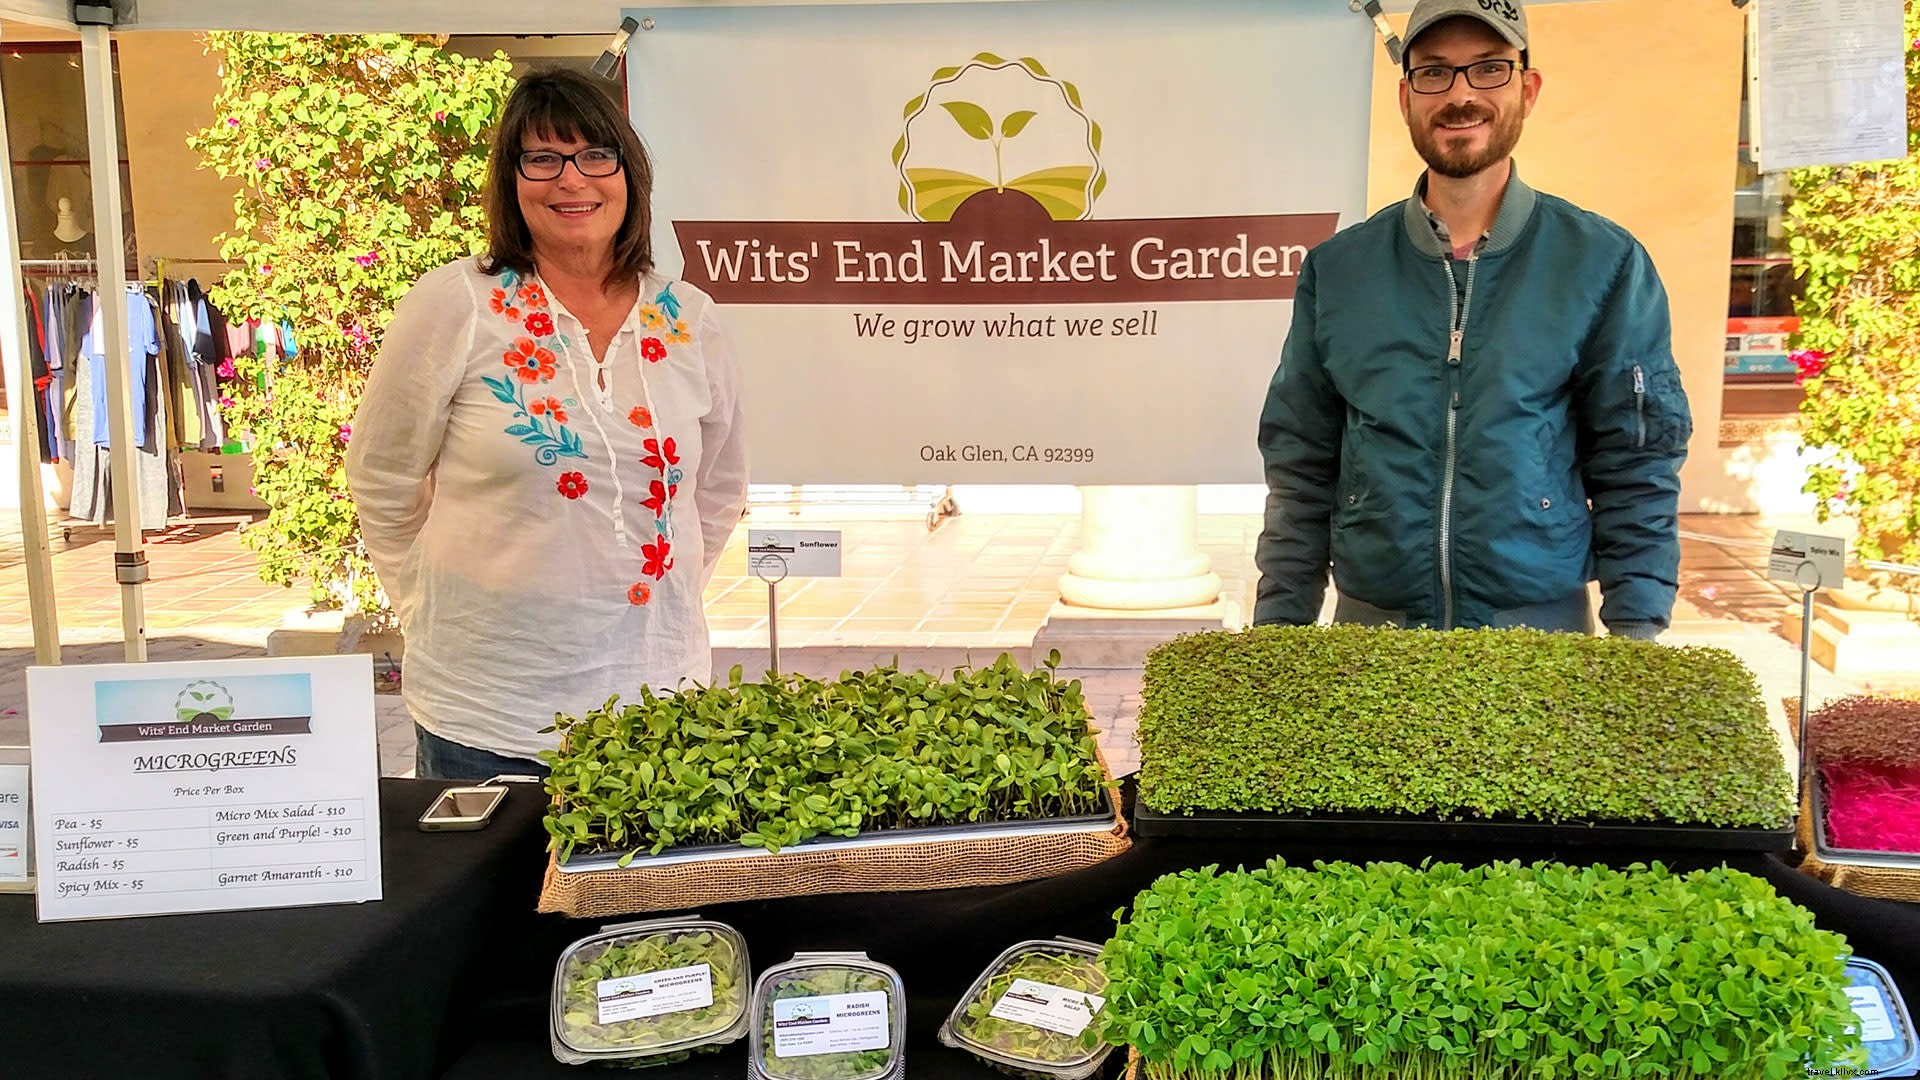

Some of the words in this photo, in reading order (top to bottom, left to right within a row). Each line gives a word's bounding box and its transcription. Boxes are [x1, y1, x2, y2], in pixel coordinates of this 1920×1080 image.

[696, 238, 819, 283] Wits'
[833, 239, 928, 283] End
[939, 238, 1118, 283] Market
[1130, 233, 1308, 281] Garden
[853, 312, 896, 338] We
[903, 318, 975, 345] grow
[983, 312, 1056, 338] what
[1064, 318, 1104, 337] we
[1111, 310, 1159, 337] sell
[920, 445, 957, 462] Oak
[961, 445, 1008, 463] Glen,
[1012, 445, 1039, 462] CA
[1044, 447, 1094, 463] 92399
[138, 726, 166, 736] Wits'
[168, 725, 189, 735] End
[192, 723, 231, 734] Market
[233, 721, 272, 732] Garden
[133, 745, 297, 772] MICROGREENS
[173, 786, 200, 797] Price
[203, 785, 220, 795] Per
[224, 784, 244, 795] Box
[216, 810, 251, 822] Micro
[254, 808, 279, 819] Mix
[282, 803, 317, 818] Salad
[326, 807, 346, 816] $10
[55, 819, 77, 830] Pea
[90, 819, 103, 830] $5
[216, 831, 250, 845] Green
[253, 827, 278, 840] and
[279, 825, 320, 843] Purple!
[332, 827, 352, 836] $10
[56, 836, 114, 855] Sunflower
[126, 838, 139, 848] $5
[57, 857, 100, 871] Radish
[112, 860, 125, 870] $5
[218, 873, 259, 887] Garnet
[261, 866, 322, 881] Amaranth
[334, 868, 353, 877] $10
[58, 882, 90, 897] Spicy
[93, 880, 119, 891] Mix
[131, 880, 145, 890] $5
[659, 978, 703, 988] MICROGREENS
[836, 1010, 881, 1018] MICROGREENS
[846, 1002, 870, 1010] RADISH
